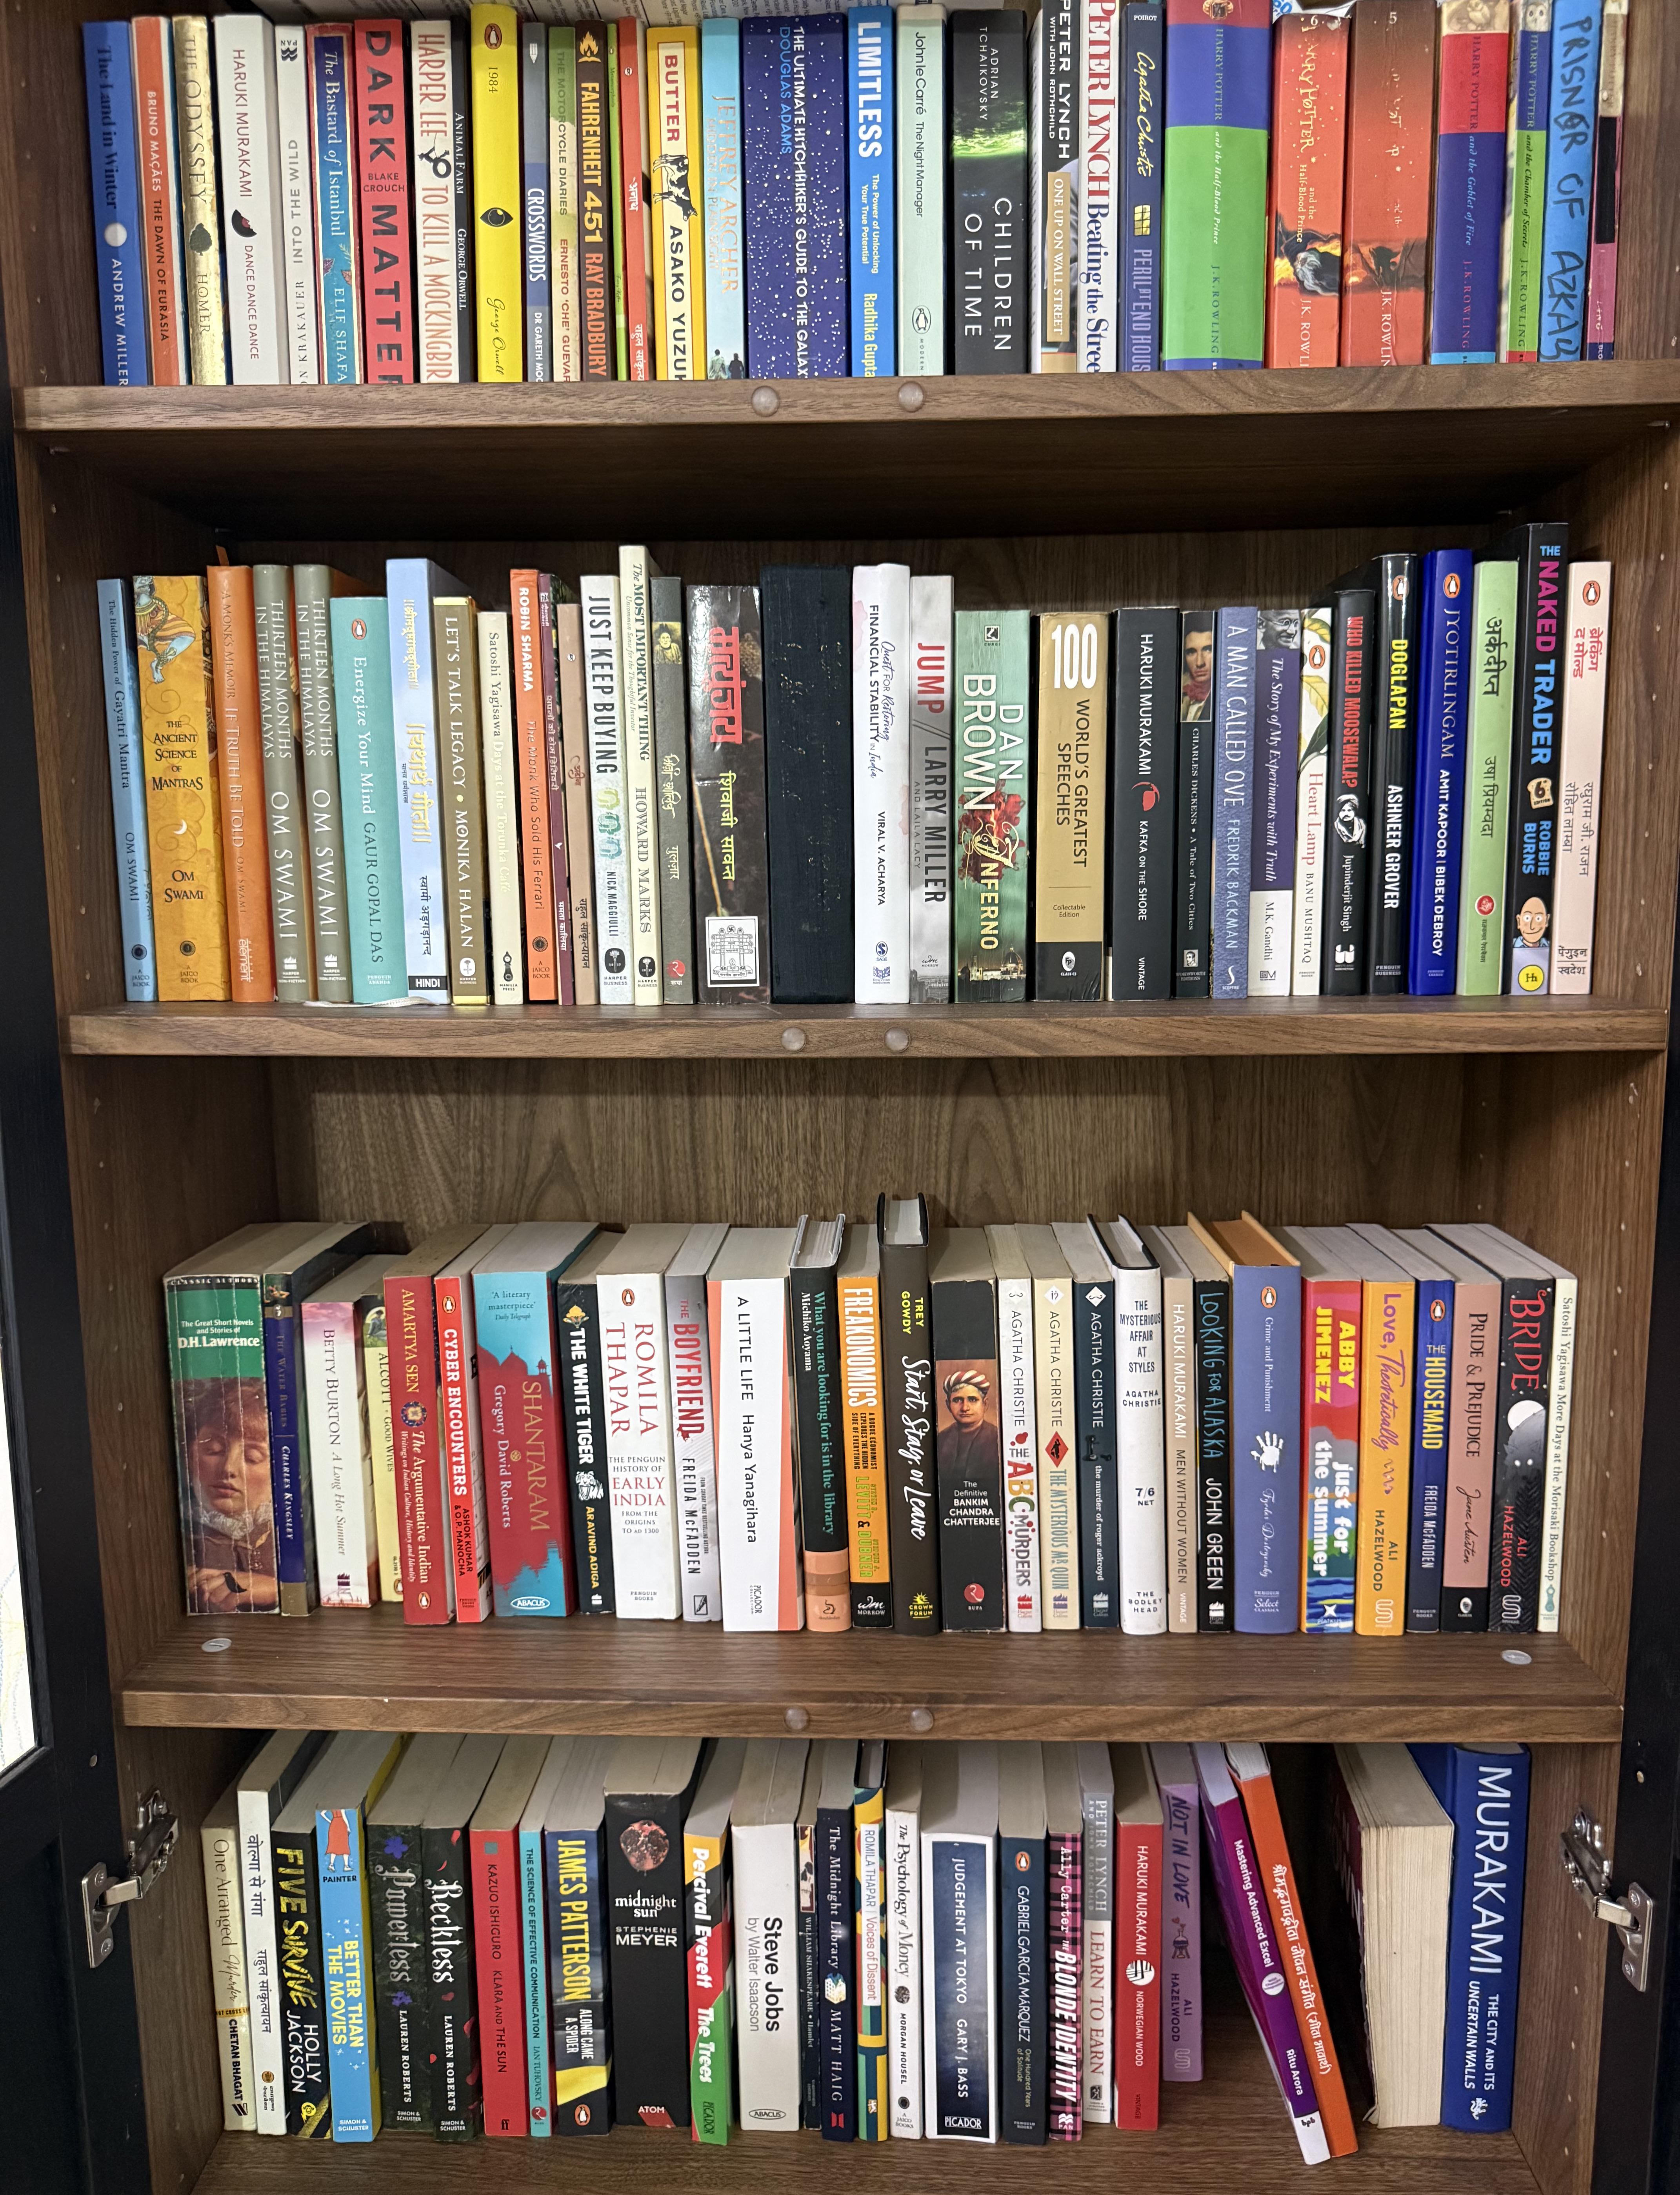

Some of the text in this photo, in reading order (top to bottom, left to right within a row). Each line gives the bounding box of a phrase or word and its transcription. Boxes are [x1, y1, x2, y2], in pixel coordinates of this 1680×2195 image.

[488, 67, 498, 94] 1984
[664, 55, 681, 142] BUTTER
[857, 22, 883, 158] LIMITLESS
[978, 27, 988, 121] TCHAIKOVSKY
[989, 47, 999, 100] ADRIAN
[146, 91, 161, 192] BRUNO MAÇÃES
[233, 49, 253, 197] HARUKI MURAKAMI
[455, 113, 464, 194] ANIMAL FARM
[363, 183, 405, 193] CROUCH
[368, 172, 400, 181] BLAKE
[580, 82, 604, 242] FAHRENHEIT 451
[1553, 172, 1585, 219] OF
[288, 140, 304, 264] INTO THE WILD
[527, 187, 546, 282] CROSSWORDS
[153, 199, 169, 341] THE DAWN OF EURASIA
[457, 228, 467, 310] GEORGE ORWELL
[669, 225, 685, 303] ASAKO
[964, 214, 983, 337] OF TIME
[994, 198, 1013, 351] CHILDREN
[1053, 178, 1064, 334] ONE UP ON WALL STREET
[585, 253, 607, 376] RAY BRADBURY
[1540, 546, 1561, 556] THE
[518, 587, 534, 692] ROBIN SHARMA
[1535, 561, 1559, 652] NAKED
[271, 600, 292, 758] THIRTEEN MONTHS
[588, 596, 618, 774] JUST KEEP BUYING
[916, 643, 945, 714] JUMP
[1051, 624, 1097, 689] 100
[1389, 640, 1408, 729] DOGLAPAN
[153, 733, 197, 744] ANCIENT
[1138, 633, 1154, 775] HARUKI MURAKAMI
[1531, 659, 1555, 765] TRADER
[155, 749, 197, 761] SCIENCE
[963, 674, 996, 810] BROWN
[999, 704, 1024, 779] DAN
[152, 777, 204, 791] MANTRAS
[719, 770, 738, 828] शिवाजी
[924, 745, 947, 903] LARRY MILLER
[1522, 823, 1536, 874] BURNS
[1537, 820, 1552, 876] ROBBIE
[165, 888, 204, 903] SWAMI
[172, 869, 195, 882] OM
[363, 822, 384, 963] GAUR GOPAL DAS
[456, 810, 473, 948] MONIKA HALAN
[416, 978, 440, 988] HINDI
[1558, 966, 1586, 976] स्वदेश
[401, 1288, 419, 1393] AMARTYA SEN
[901, 1291, 912, 1335] GOWDY
[914, 1297, 924, 1327] TREY
[1120, 1313, 1161, 1326] MYSTERIOUS
[1129, 1330, 1154, 1342] AFFAIR
[1134, 1300, 1148, 1311] THE
[843, 1288, 878, 1408] FREAKONOMICS
[1128, 1361, 1155, 1374] STYLES
[1136, 1347, 1147, 1358] AT
[1315, 1306, 1333, 1403] JIMENEZ
[1338, 1320, 1356, 1389] ABBY
[444, 1328, 467, 1497] CYBER ENCOUNTERS
[569, 1329, 593, 1465] THE WHITE TIGER
[1122, 1398, 1161, 1408] CHRISTIE
[1125, 1389, 1159, 1399] AGATHA
[612, 1477, 664, 1490] EARLY
[627, 1456, 665, 1464] PENGUIN
[613, 1493, 666, 1507] INDIA
[943, 1517, 1001, 1526] CHATTERJEE
[949, 1508, 994, 1517] CHANDRA
[953, 1498, 989, 1506] BANKIM
[615, 1889, 676, 1910] midnight
[1469, 1766, 1513, 1974] MURAKAMI
[487, 1863, 502, 1960] KAZUO ISHIGURO
[557, 1839, 592, 2000] JAMES PATTERSON
[615, 1935, 677, 1947] MEYER
[633, 1906, 658, 1918] sun
[952, 1859, 967, 2004] JUDGEMENT AT TOKYO
[764, 1917, 785, 2032] Steve Jobs
[1089, 1930, 1105, 2076] LEARN TO EARN
[286, 2010, 306, 2093] JACKSON
[1134, 1990, 1143, 2042] NORWEGIAN
[228, 2019, 244, 2101] CHETAN BHAGAT
[303, 2024, 322, 2083] HOLLY
[638, 2105, 665, 2113] ATOM
[945, 2117, 982, 2129] PICADOR
